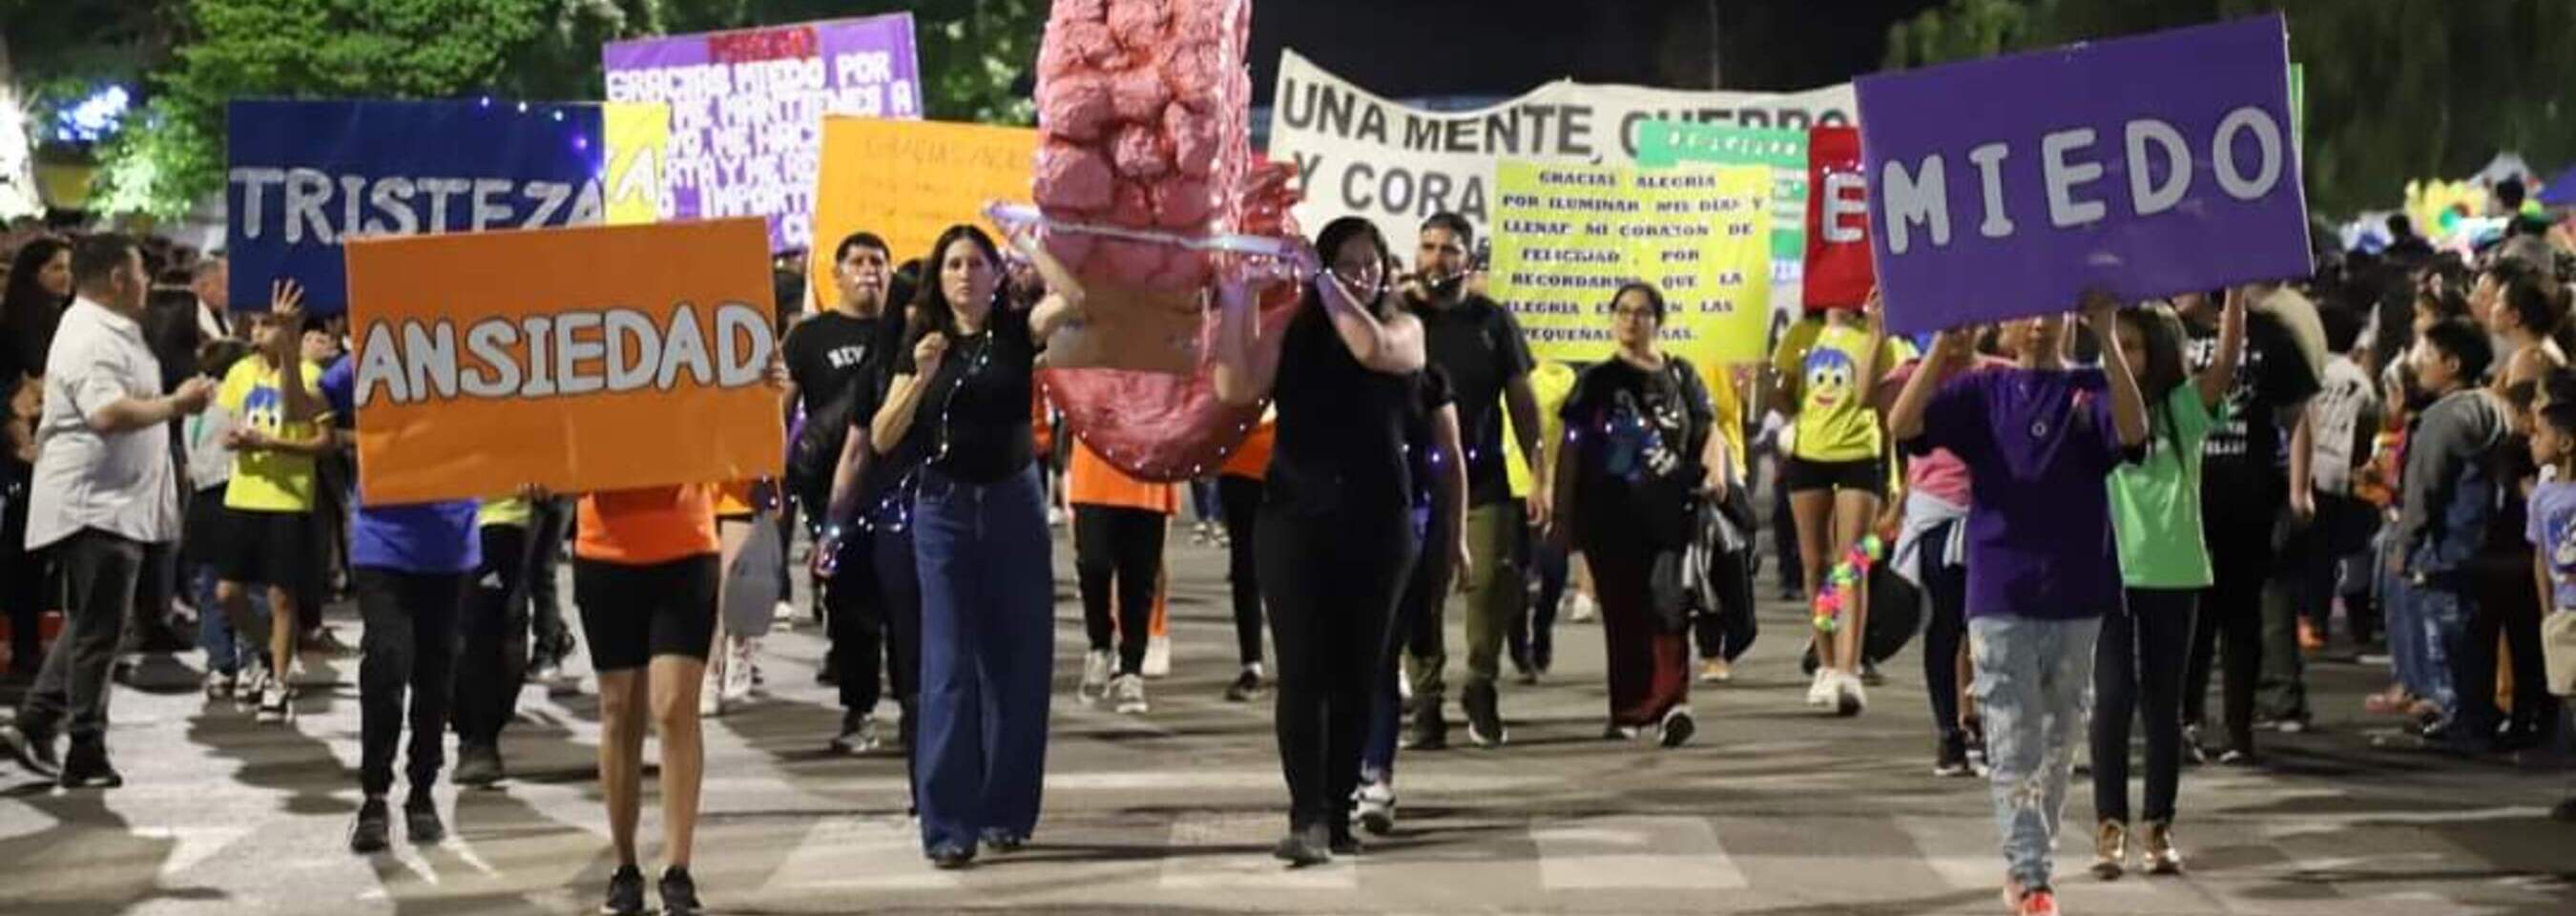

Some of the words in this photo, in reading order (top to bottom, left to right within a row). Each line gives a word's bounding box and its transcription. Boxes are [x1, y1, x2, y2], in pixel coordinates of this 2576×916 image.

[606, 62, 732, 102] GRACIAS
[734, 56, 826, 91] MIEDO
[836, 50, 892, 86] POR
[890, 78, 914, 115] A
[1282, 77, 1388, 145] UNA
[1402, 102, 1604, 164] MENTE,
[1293, 150, 1322, 202] Y
[1340, 160, 1490, 224] CORA
[1538, 172, 1616, 185] GRACIAS
[1881, 105, 2284, 255] MIEDO
[228, 166, 605, 245] TRISTEZA
[1503, 195, 1538, 207] POR
[1548, 197, 1639, 211] ILUMINAR
[1823, 170, 1868, 243] E
[1503, 219, 1571, 235] LLENAR
[1585, 222, 1609, 236] MI
[1728, 223, 1754, 236] DE
[1522, 247, 1621, 263] FELICIDAD
[1661, 249, 1699, 263] POR
[1661, 274, 1694, 289] QUE
[1719, 272, 1742, 285] LA
[1700, 301, 1734, 313] LAS
[353, 299, 774, 407] ANSIEDAD
